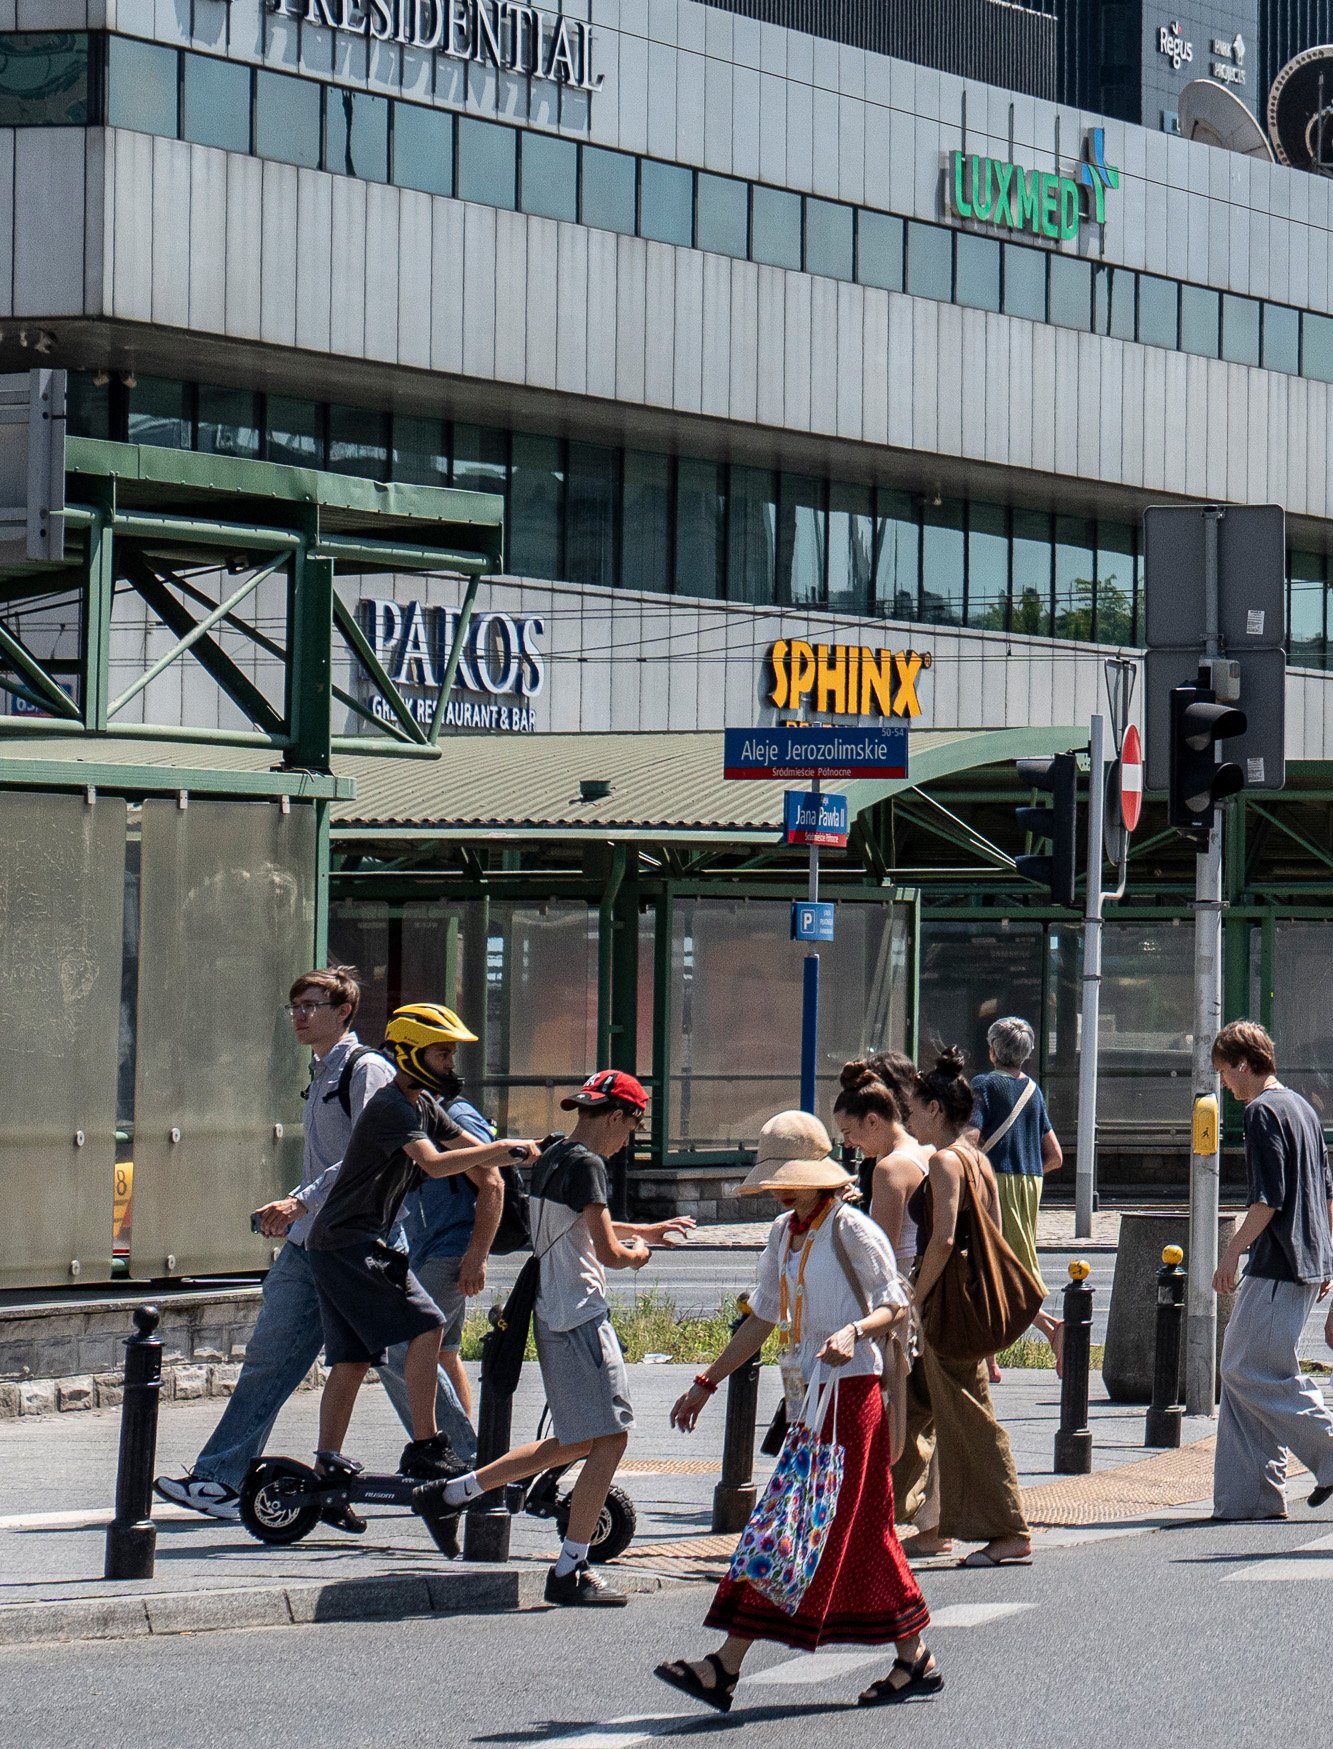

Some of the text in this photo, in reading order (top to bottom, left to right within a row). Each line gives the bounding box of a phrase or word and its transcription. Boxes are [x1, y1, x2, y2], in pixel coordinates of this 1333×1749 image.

[275, 0, 606, 92] SIDENTIAL
[1160, 27, 1193, 69] Regus
[954, 150, 1079, 241] LUXMED
[771, 639, 923, 718] SPHINX
[372, 695, 537, 732] GRK REAURANT & BAR
[881, 727, 905, 737] 50-54
[741, 737, 888, 766] Aleje Jerozolimskie
[771, 767, 852, 777] Śródmieście Północne
[796, 805, 845, 828] Jana Pawła II
[803, 912, 813, 930] P
